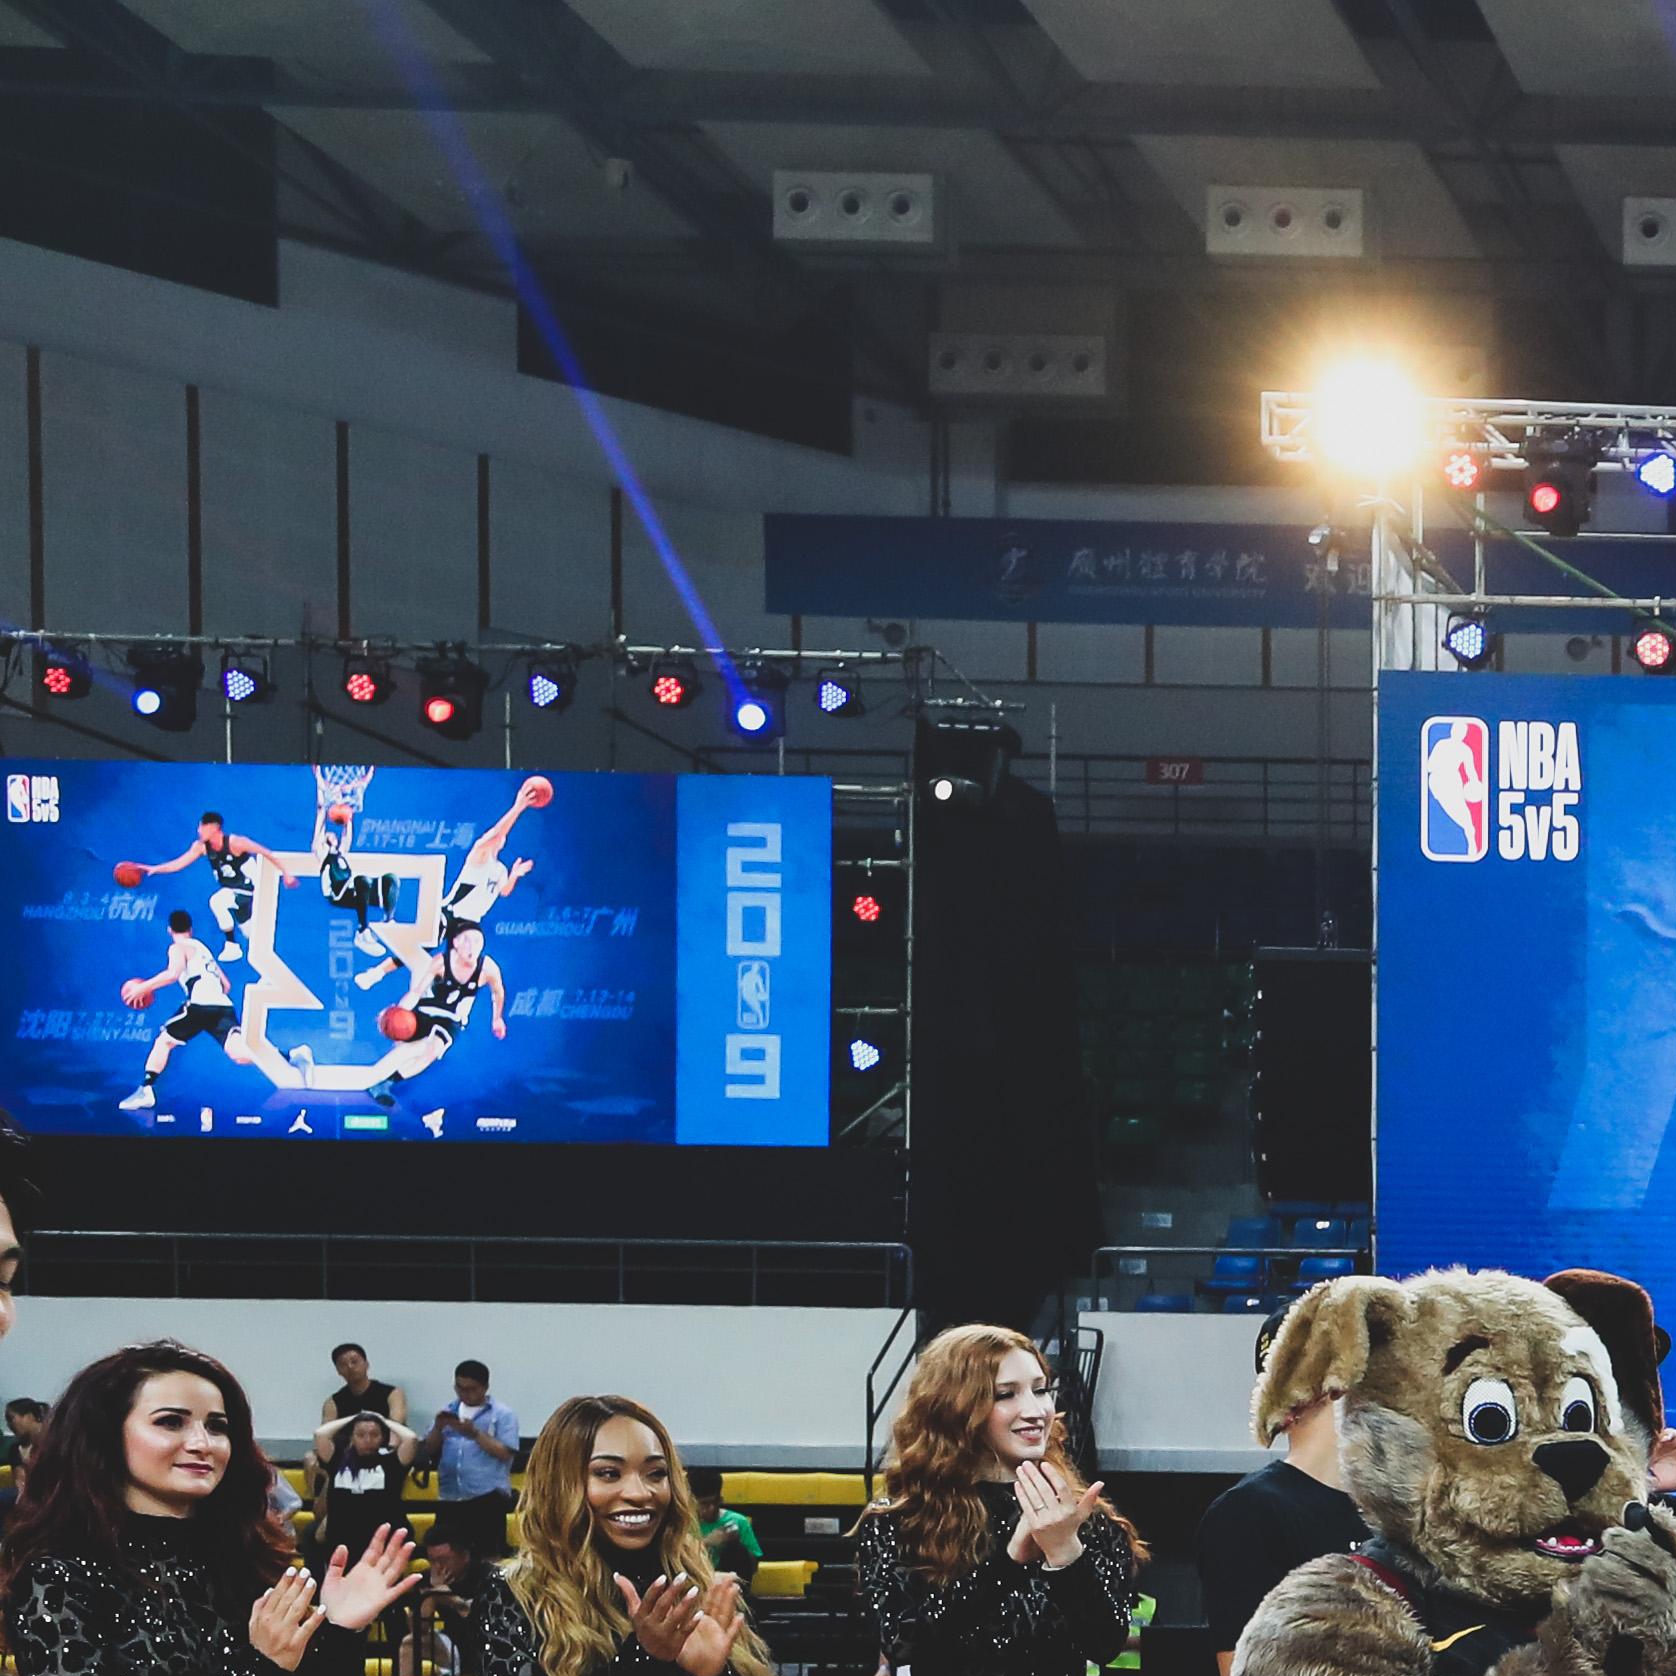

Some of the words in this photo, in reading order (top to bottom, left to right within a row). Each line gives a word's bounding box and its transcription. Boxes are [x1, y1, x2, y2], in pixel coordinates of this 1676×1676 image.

[1159, 762, 1190, 780] 307
[1499, 720, 1582, 791] NBA
[1498, 791, 1580, 862] 5v5
